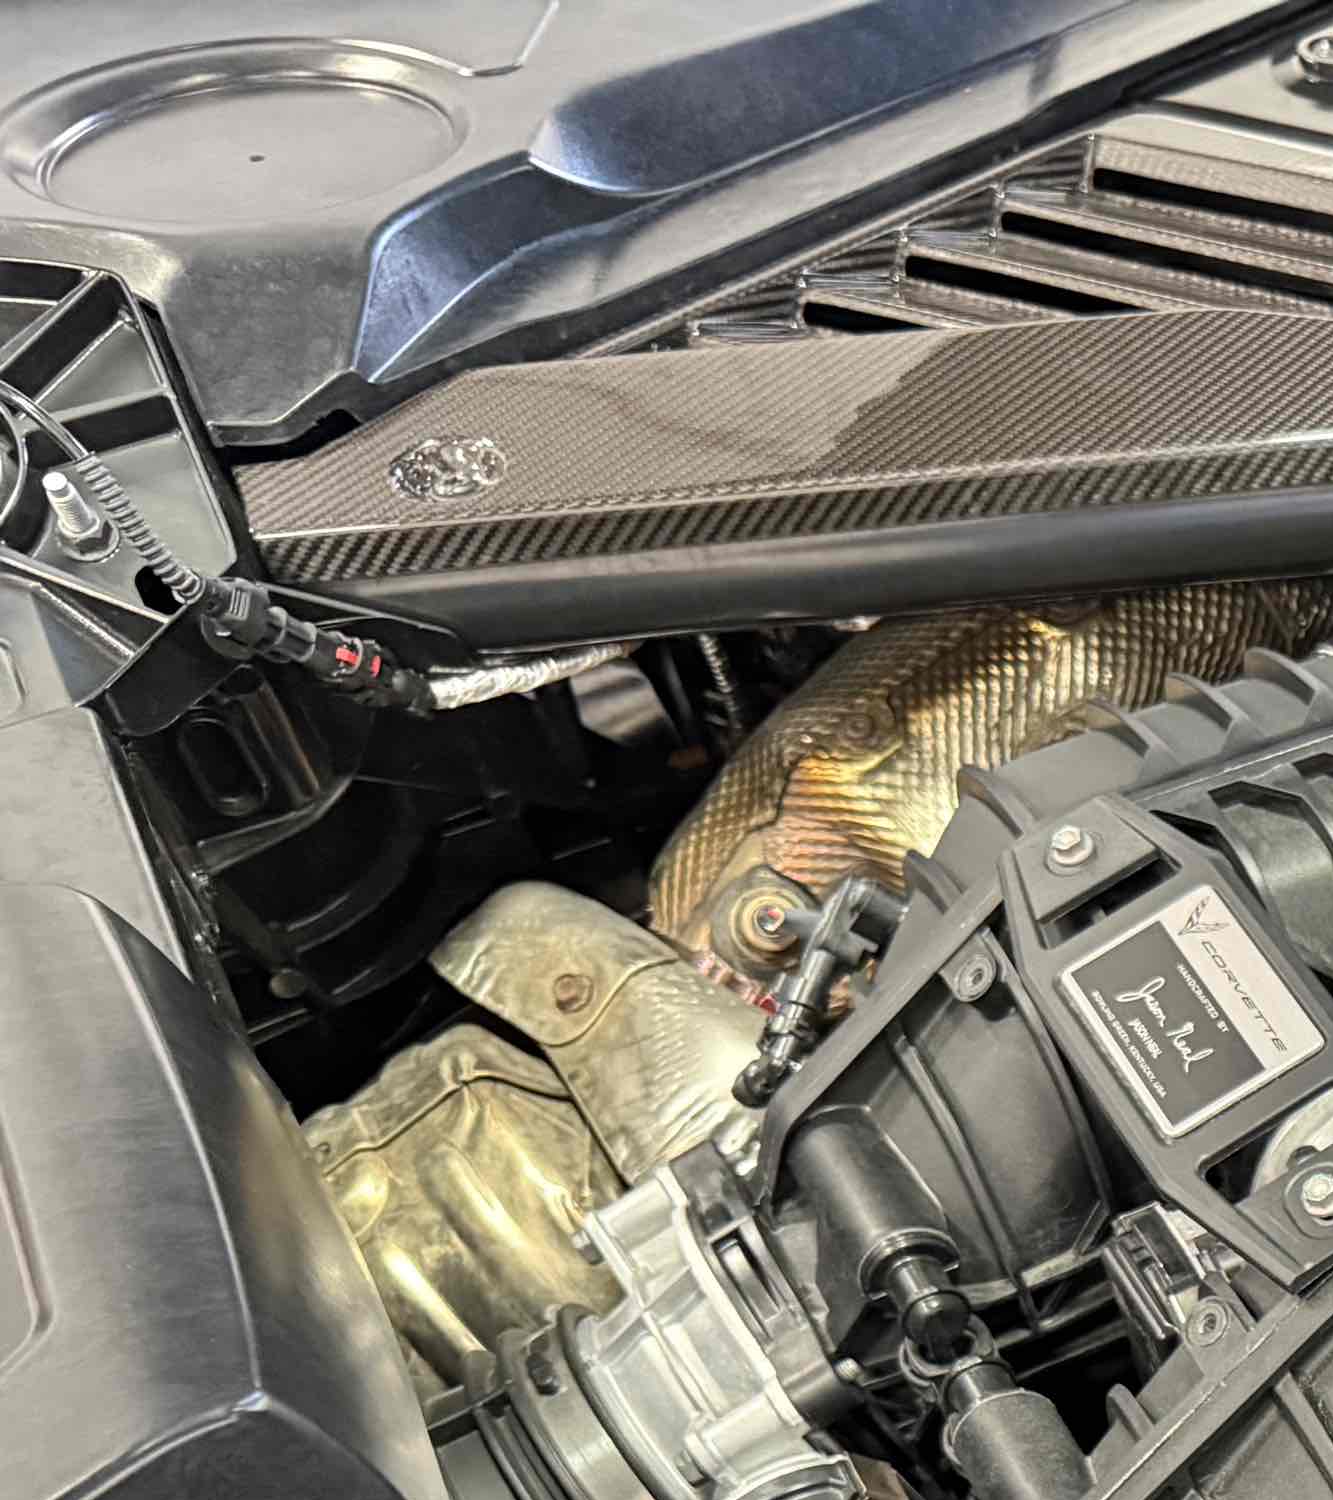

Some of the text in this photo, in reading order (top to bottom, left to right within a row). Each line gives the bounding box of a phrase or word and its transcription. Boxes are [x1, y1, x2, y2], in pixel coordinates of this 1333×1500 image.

[1178, 964, 1229, 1031] HANDCRAFTED BY
[1201, 942, 1287, 1051] CORVETTE
